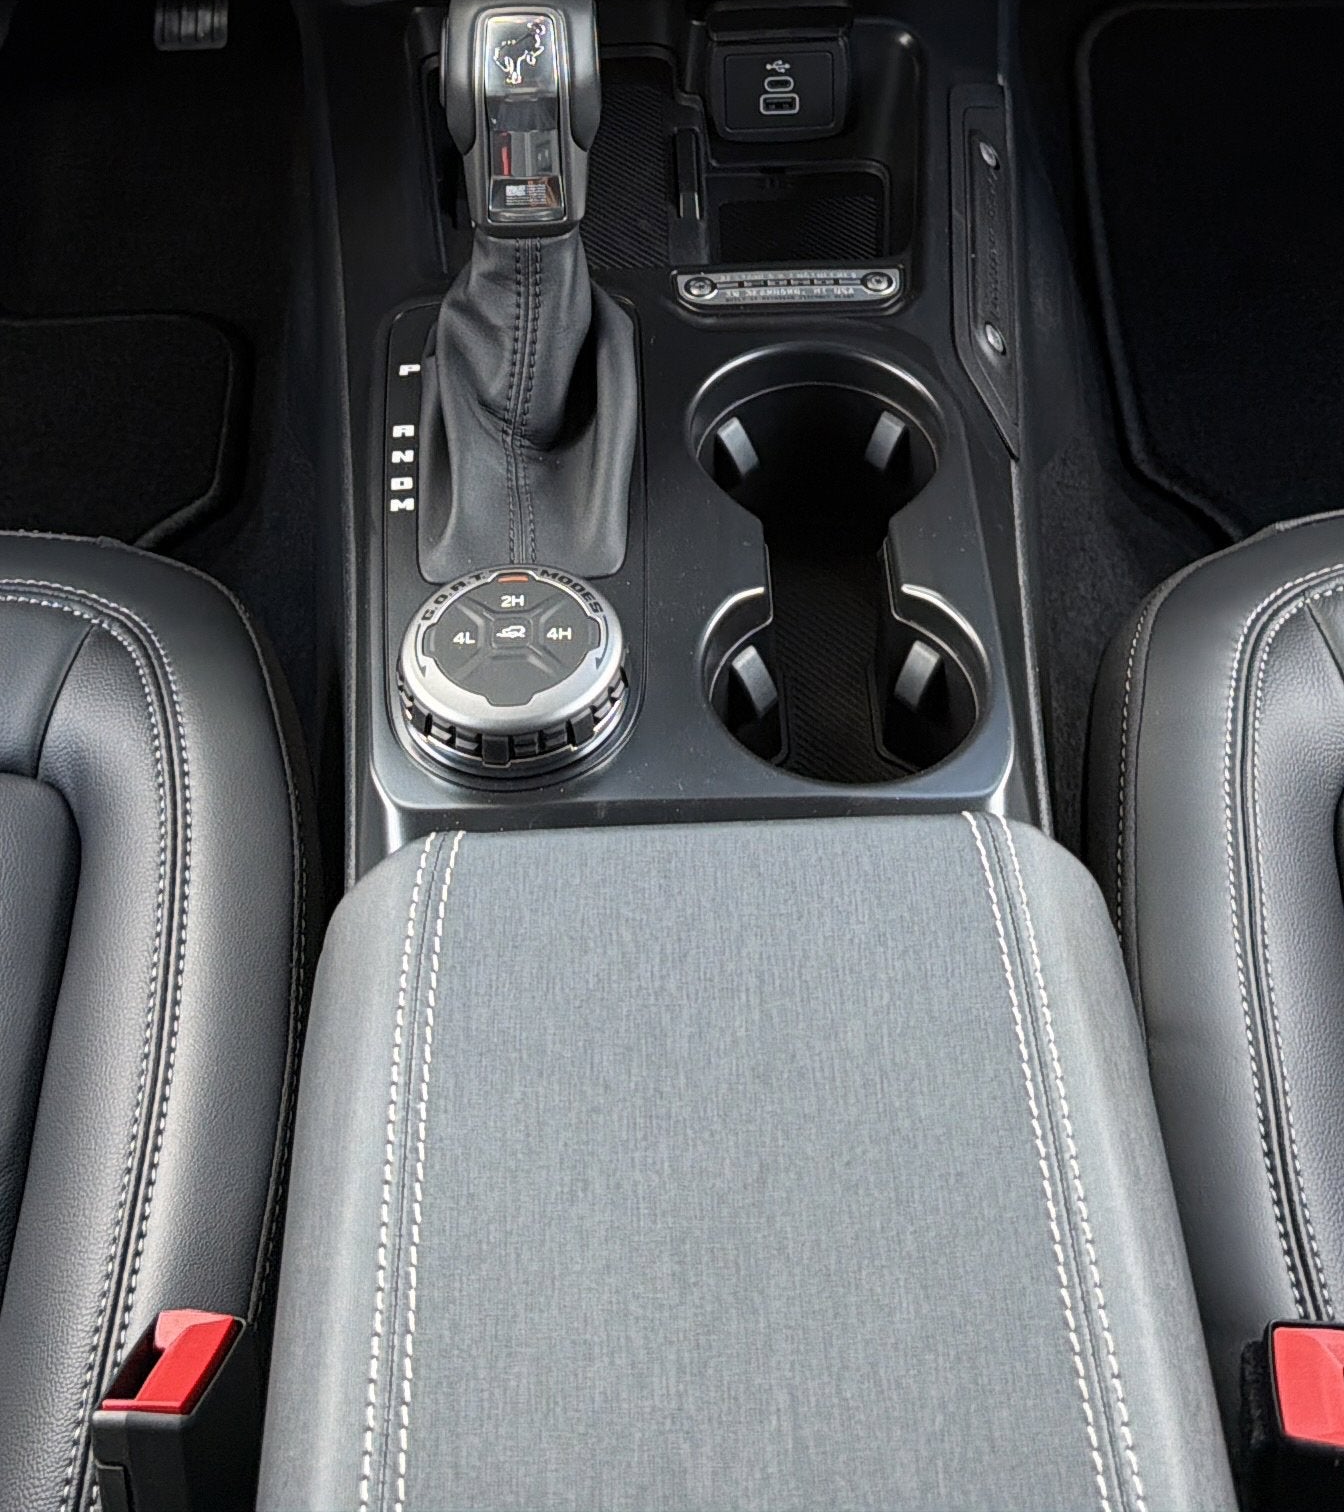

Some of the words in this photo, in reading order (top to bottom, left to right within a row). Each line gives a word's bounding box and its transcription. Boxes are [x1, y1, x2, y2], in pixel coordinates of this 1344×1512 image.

[399, 364, 421, 376] P
[392, 450, 414, 463] N
[390, 498, 414, 512] M
[541, 569, 605, 614] MODES
[500, 595, 525, 608] 2H
[453, 632, 476, 645] 4L
[546, 627, 572, 640] 4H
